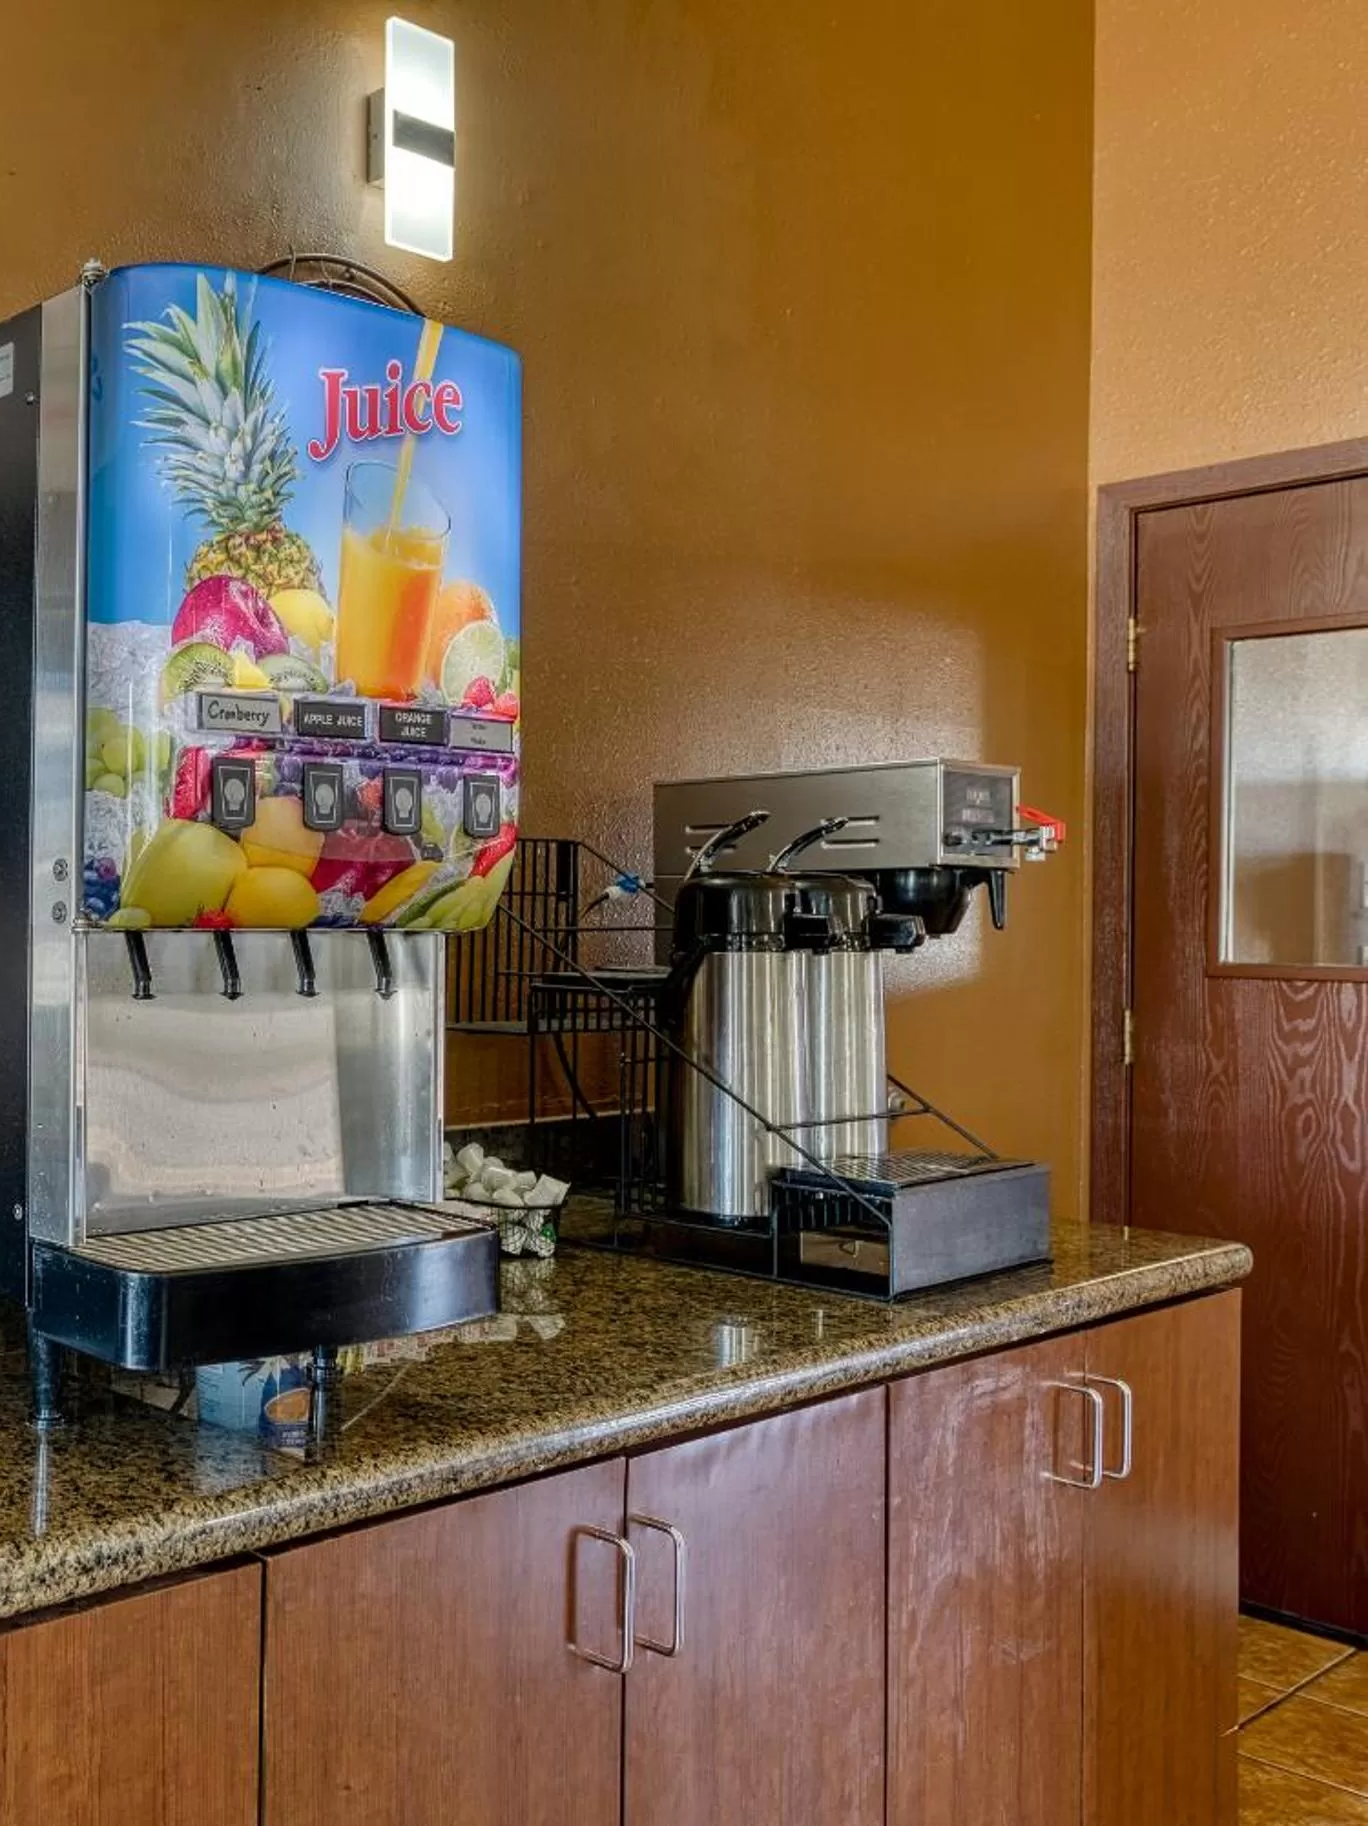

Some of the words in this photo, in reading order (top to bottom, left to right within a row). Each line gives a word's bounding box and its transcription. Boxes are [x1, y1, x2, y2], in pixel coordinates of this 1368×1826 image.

[308, 360, 463, 461] Juice
[207, 700, 271, 727] Cranberry
[303, 713, 333, 725] APPLE
[336, 715, 364, 727] JUICE
[395, 712, 433, 724] ORANGE
[400, 724, 427, 738] JUICE
